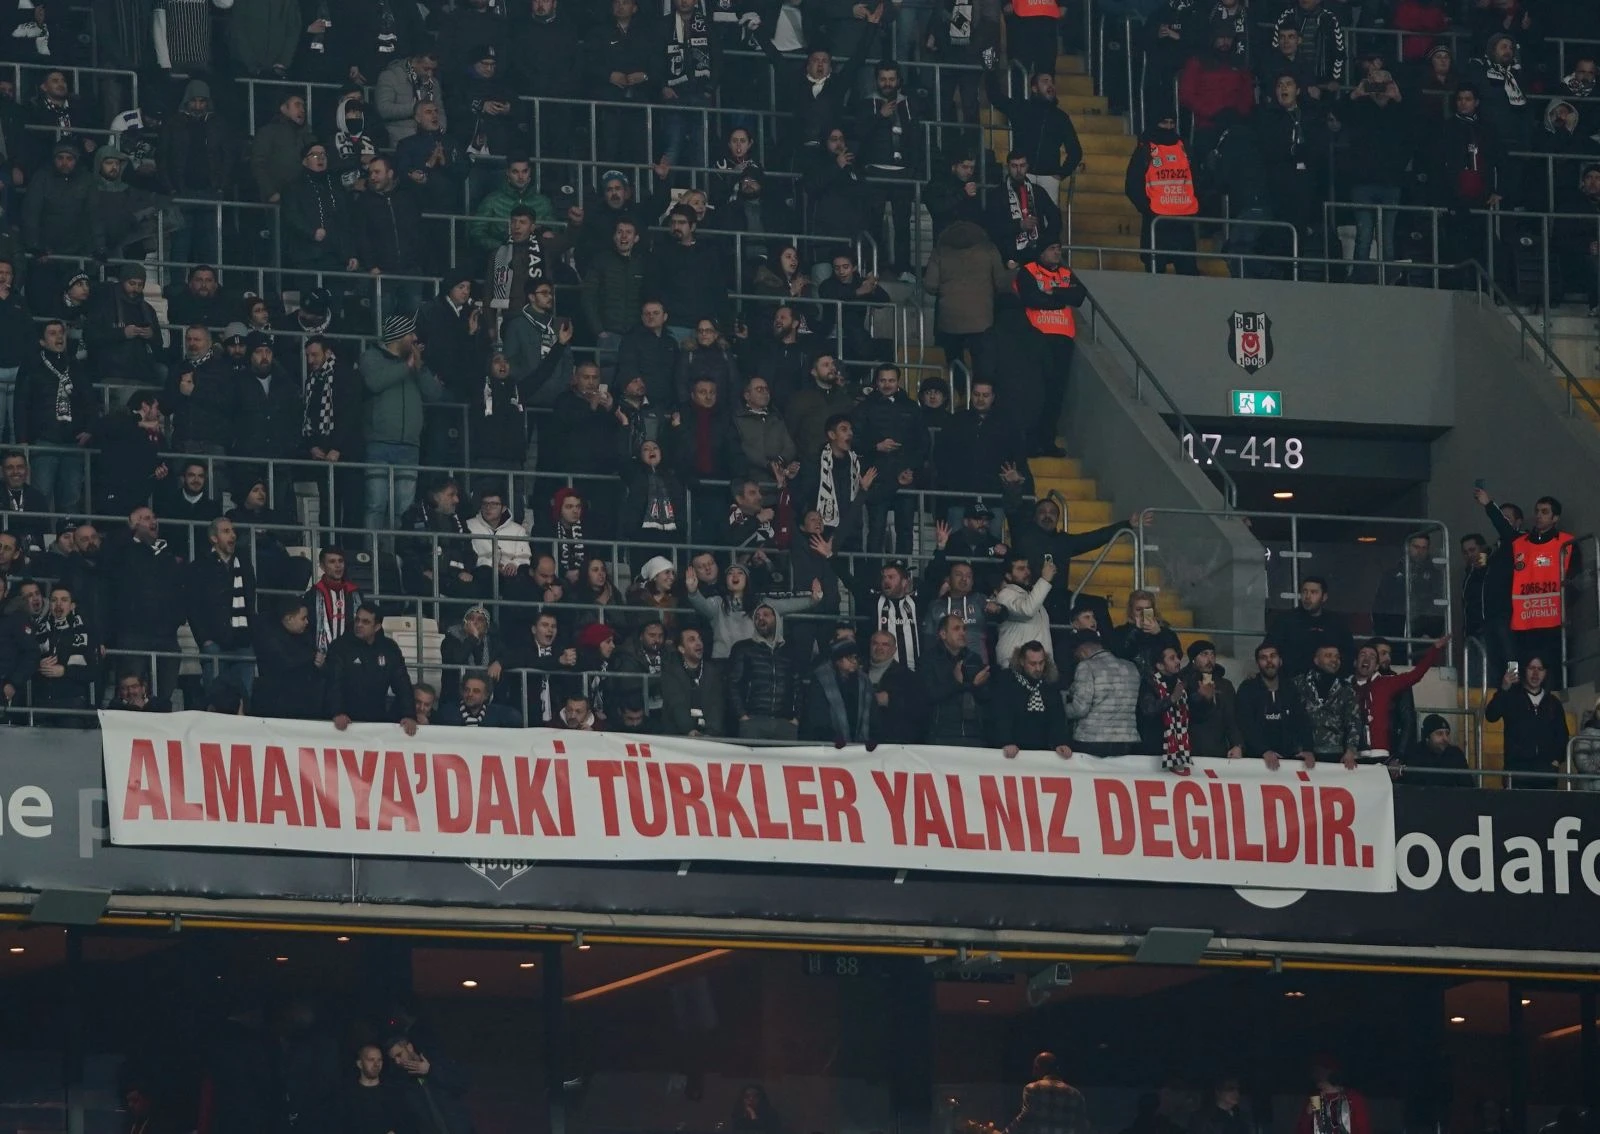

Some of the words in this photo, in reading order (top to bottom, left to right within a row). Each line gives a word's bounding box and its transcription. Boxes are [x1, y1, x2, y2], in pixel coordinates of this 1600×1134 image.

[1239, 357, 1265, 367] 1903
[586, 743, 865, 843] TÜRKLER
[871, 770, 1080, 853] YALNIZ
[1093, 767, 1374, 868] DEĞİLDİR.
